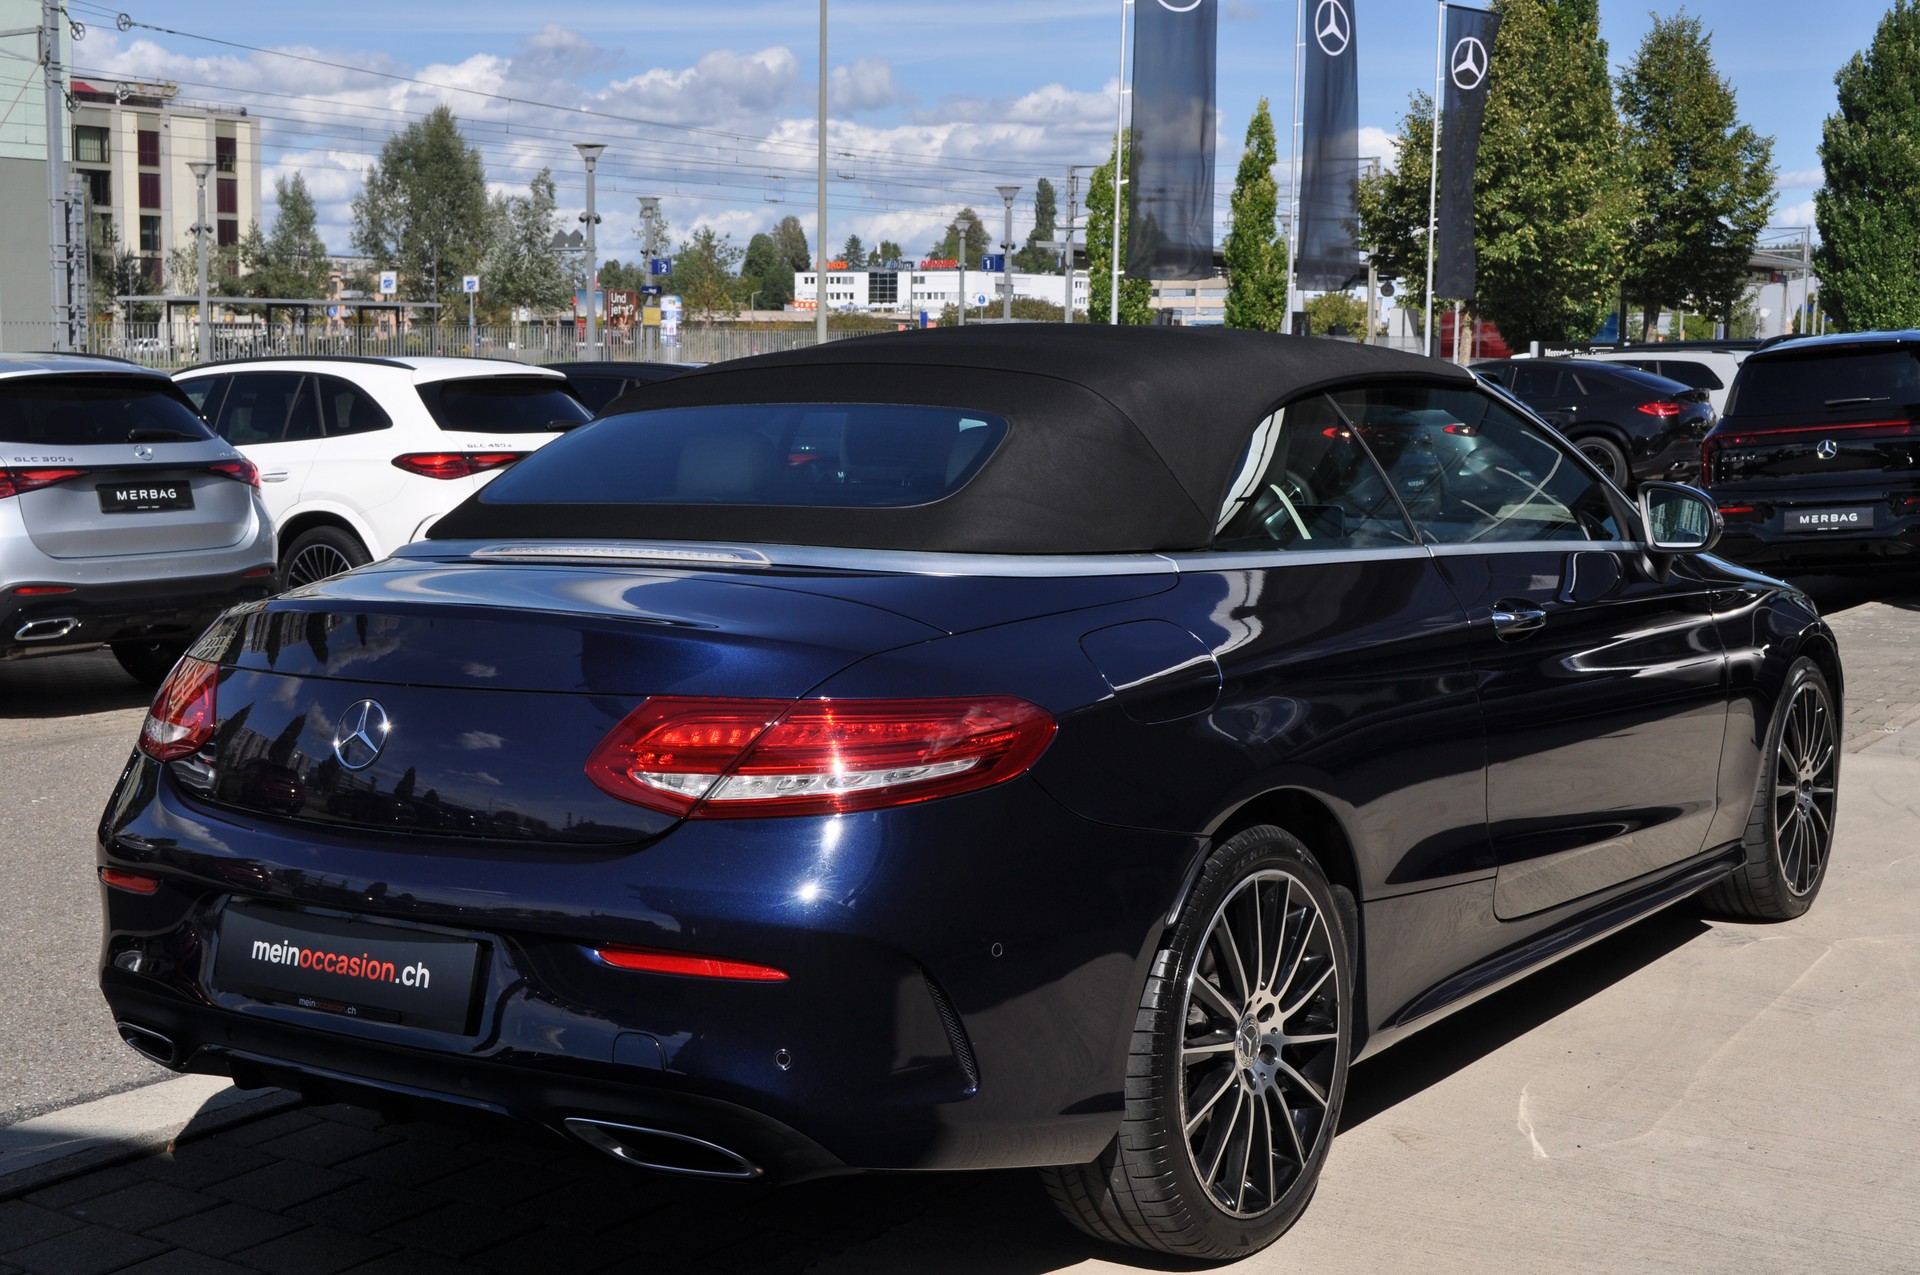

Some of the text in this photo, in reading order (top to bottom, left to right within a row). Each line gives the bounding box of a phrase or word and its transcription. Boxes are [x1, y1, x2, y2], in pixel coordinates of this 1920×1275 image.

[661, 263, 668, 273] 2
[985, 259, 991, 269] 1
[610, 292, 627, 304] Und
[116, 488, 177, 501] MERBAG
[1799, 512, 1858, 524] MERBAG
[251, 939, 431, 989] meinoccasion.ch
